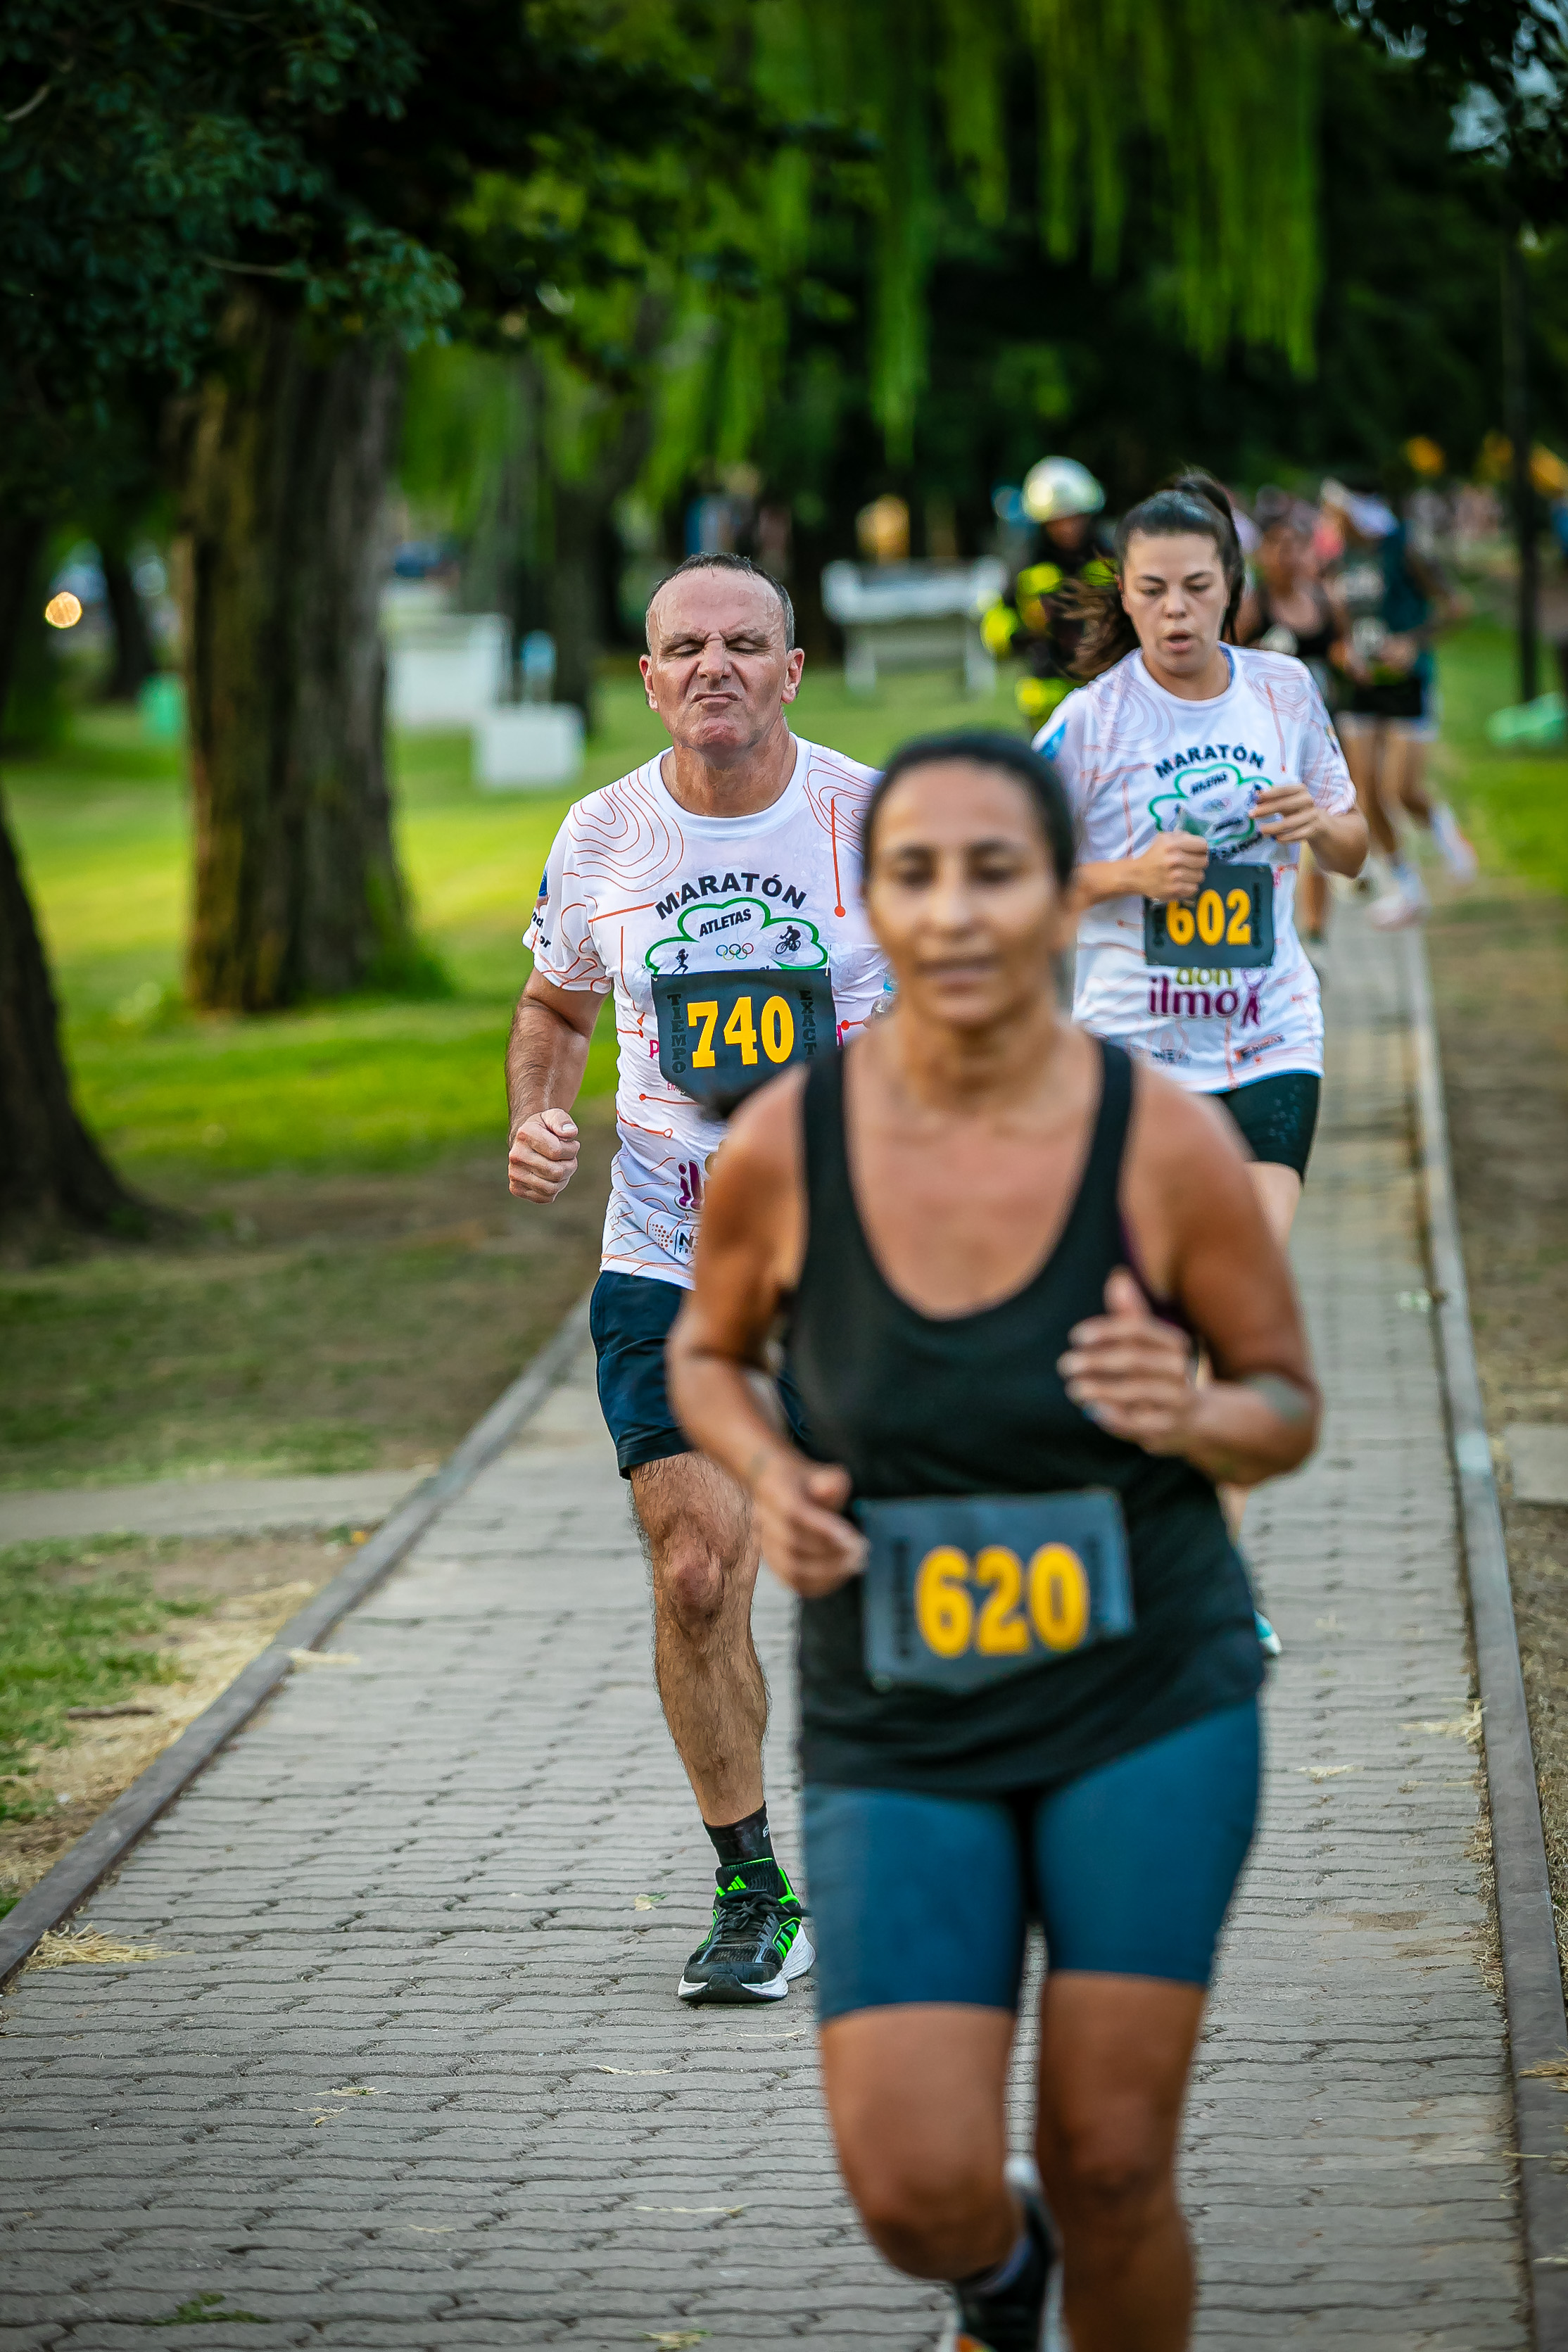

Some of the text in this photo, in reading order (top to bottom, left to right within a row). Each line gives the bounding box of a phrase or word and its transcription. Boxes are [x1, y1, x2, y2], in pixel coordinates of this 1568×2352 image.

[1155, 742, 1265, 780] MARATÓN
[655, 873, 807, 921] MARATÓN
[699, 908, 752, 937] ATLETAS
[1165, 888, 1251, 947] 602
[799, 990, 817, 1056] EXACT
[1149, 974, 1239, 1016] ilmo
[667, 993, 687, 1074] TIEMPO
[687, 995, 795, 1068] 740
[916, 1544, 1089, 1657] 620
